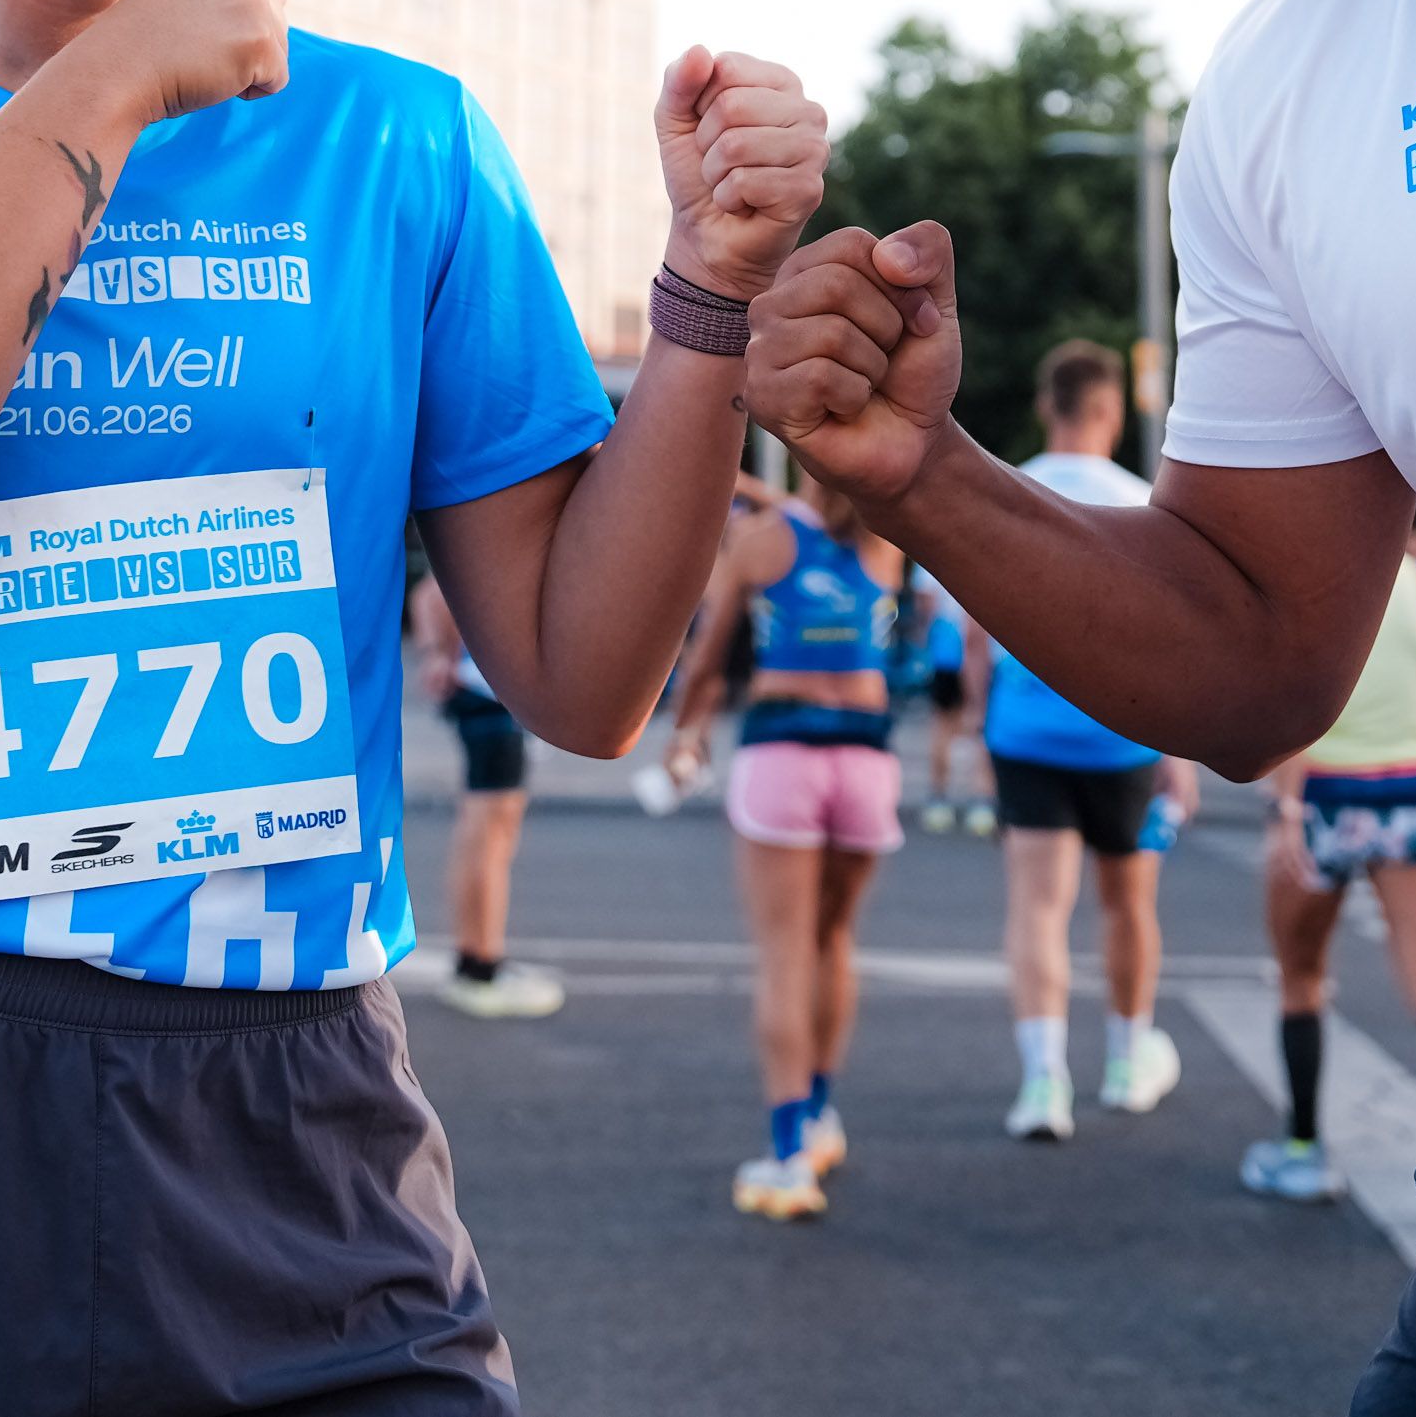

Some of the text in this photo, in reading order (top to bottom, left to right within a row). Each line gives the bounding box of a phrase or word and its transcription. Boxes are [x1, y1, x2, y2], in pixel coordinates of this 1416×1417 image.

[86, 217, 307, 246] Dutch Airlines
[98, 260, 305, 301] VS SUR
[11, 335, 244, 390] un Well
[29, 521, 104, 553] Royal
[109, 513, 190, 542] Dutch
[196, 505, 296, 533] Airlines
[122, 555, 176, 594] VS
[216, 545, 297, 584] SUR
[50, 854, 135, 874] SKECHERS
[156, 831, 240, 864] KLM
[277, 808, 347, 833] MADRID
